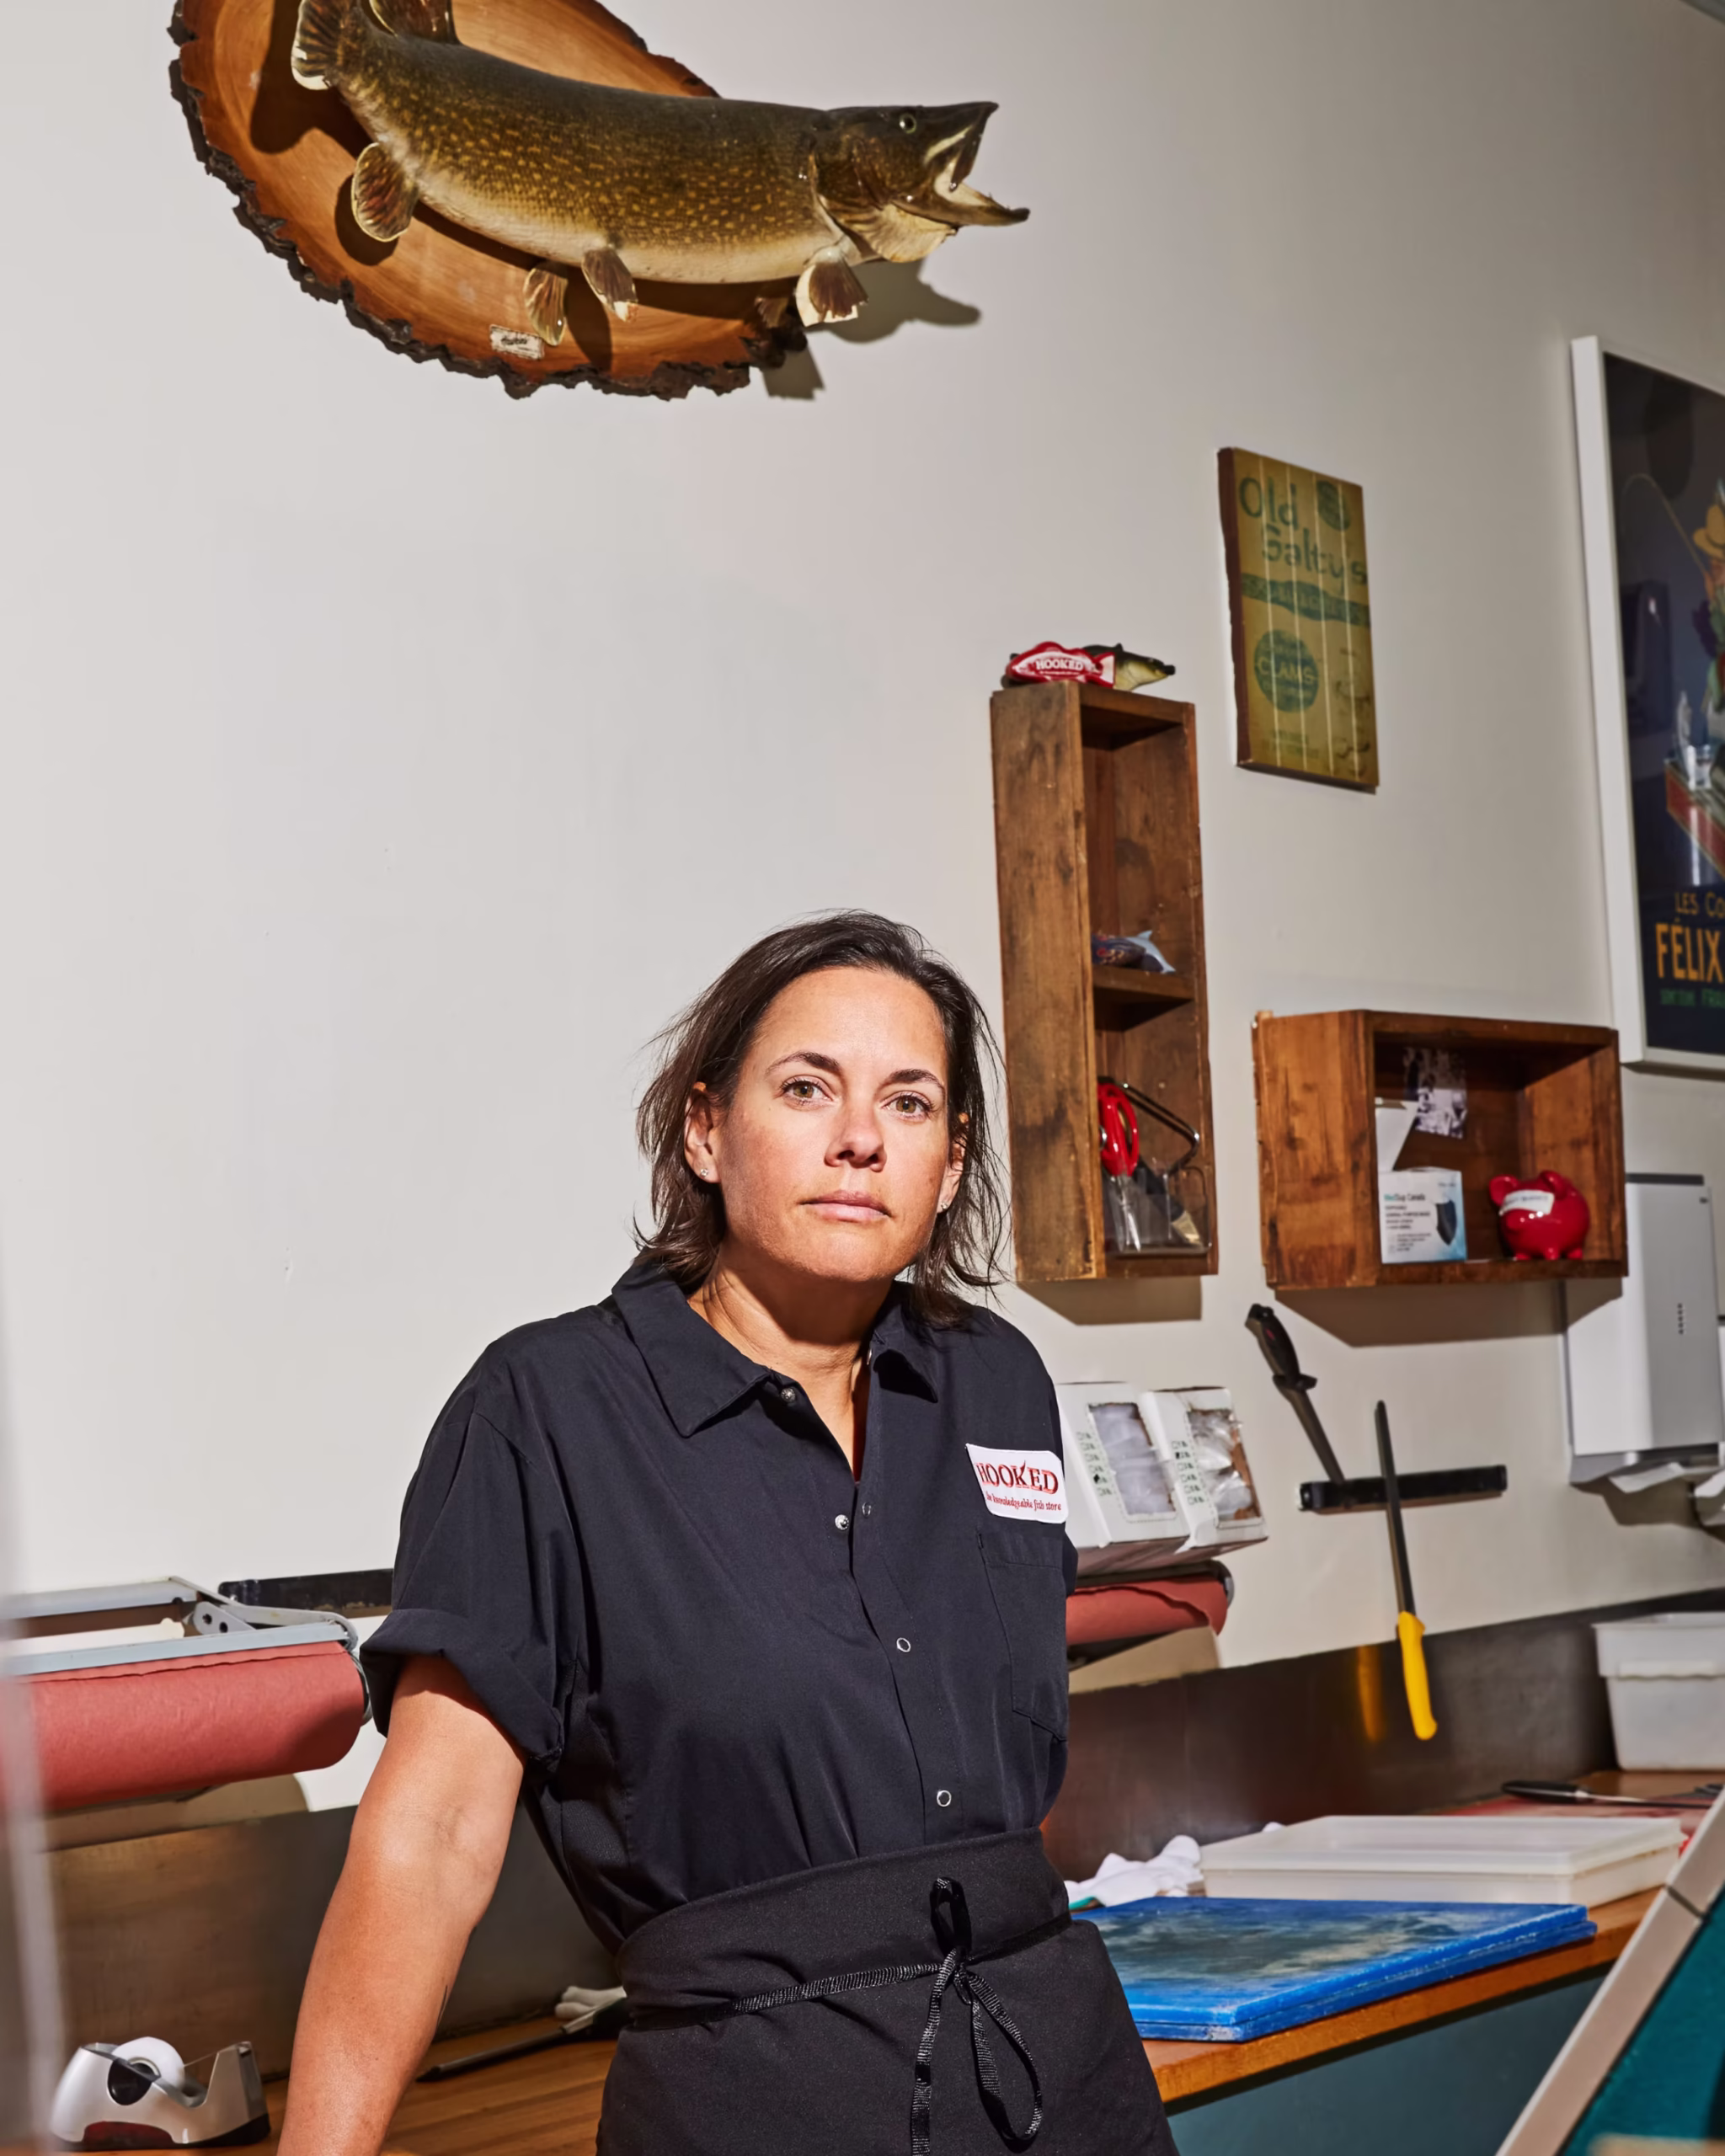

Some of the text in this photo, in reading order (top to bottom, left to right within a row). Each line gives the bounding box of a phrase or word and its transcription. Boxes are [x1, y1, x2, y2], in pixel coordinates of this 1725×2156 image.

[1239, 476, 1299, 531] Old
[1036, 659, 1083, 670] HOOKED
[1258, 656, 1314, 685] CLAMS
[1674, 892, 1699, 915] LES
[1656, 917, 1724, 984] FÉLIX
[975, 1460, 1059, 1494] HOOKED
[1033, 1499, 1044, 1512] fish
[1045, 1502, 1062, 1511] store
